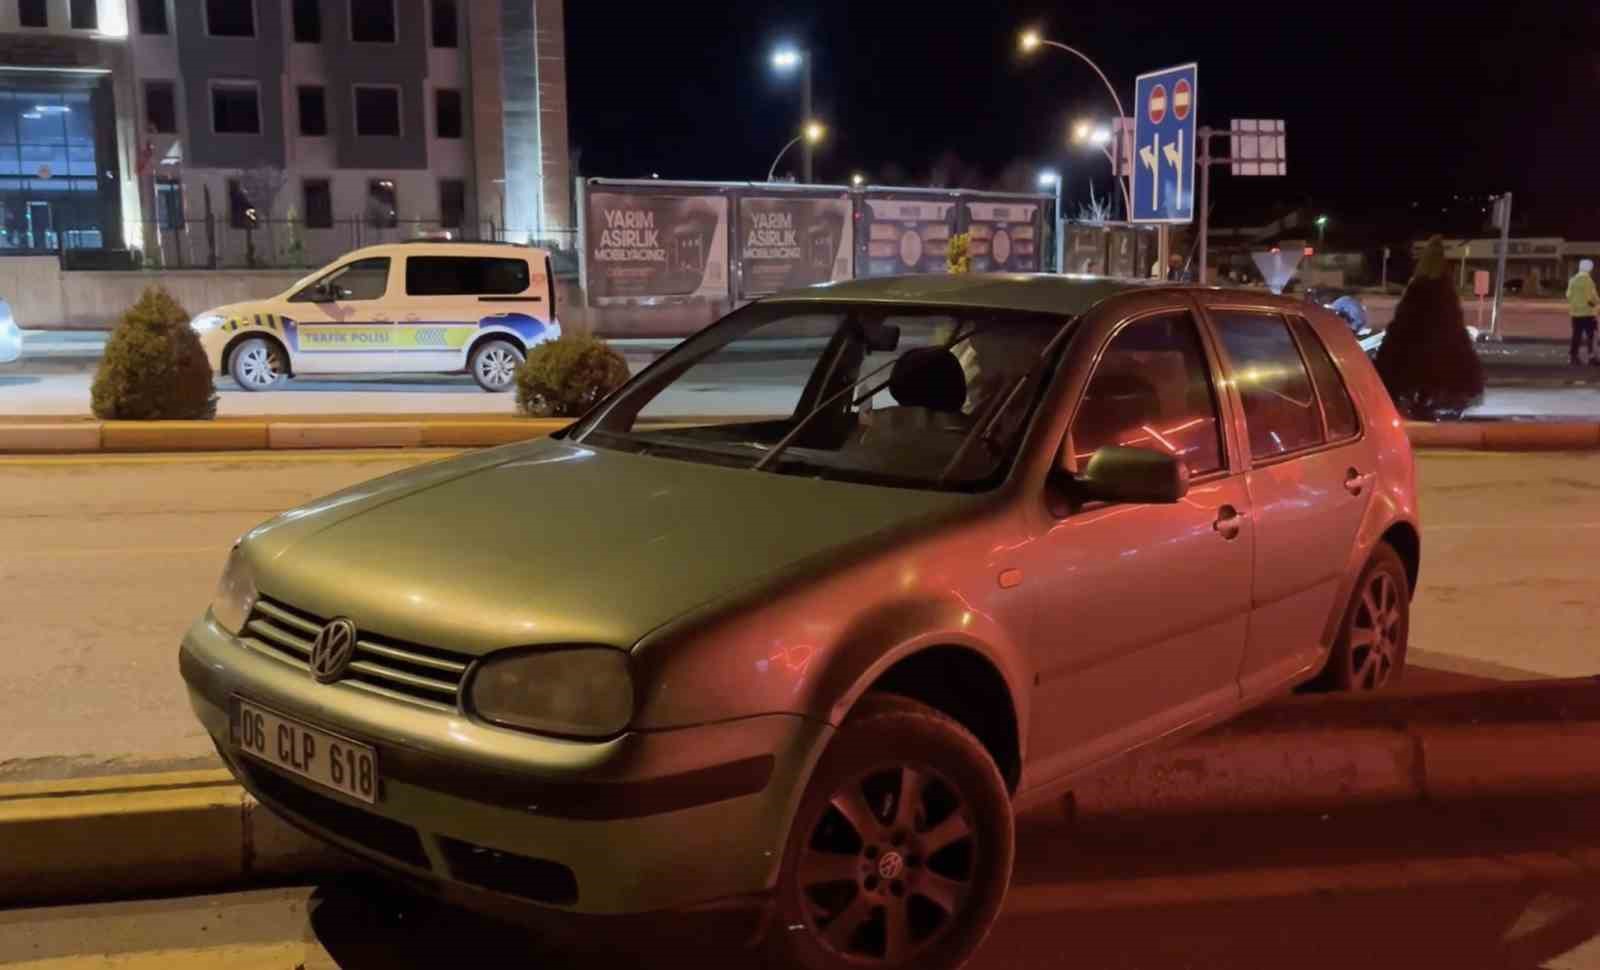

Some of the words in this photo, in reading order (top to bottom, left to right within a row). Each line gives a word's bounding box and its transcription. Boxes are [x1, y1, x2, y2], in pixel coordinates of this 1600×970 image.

[603, 209, 654, 229] YARIM
[751, 211, 793, 229] YARIM
[600, 229, 660, 248] ASIRLIK
[747, 230, 798, 247] ASIRLIK
[242, 709, 266, 753] 06
[277, 723, 316, 773] CLP
[329, 743, 373, 797] 618
